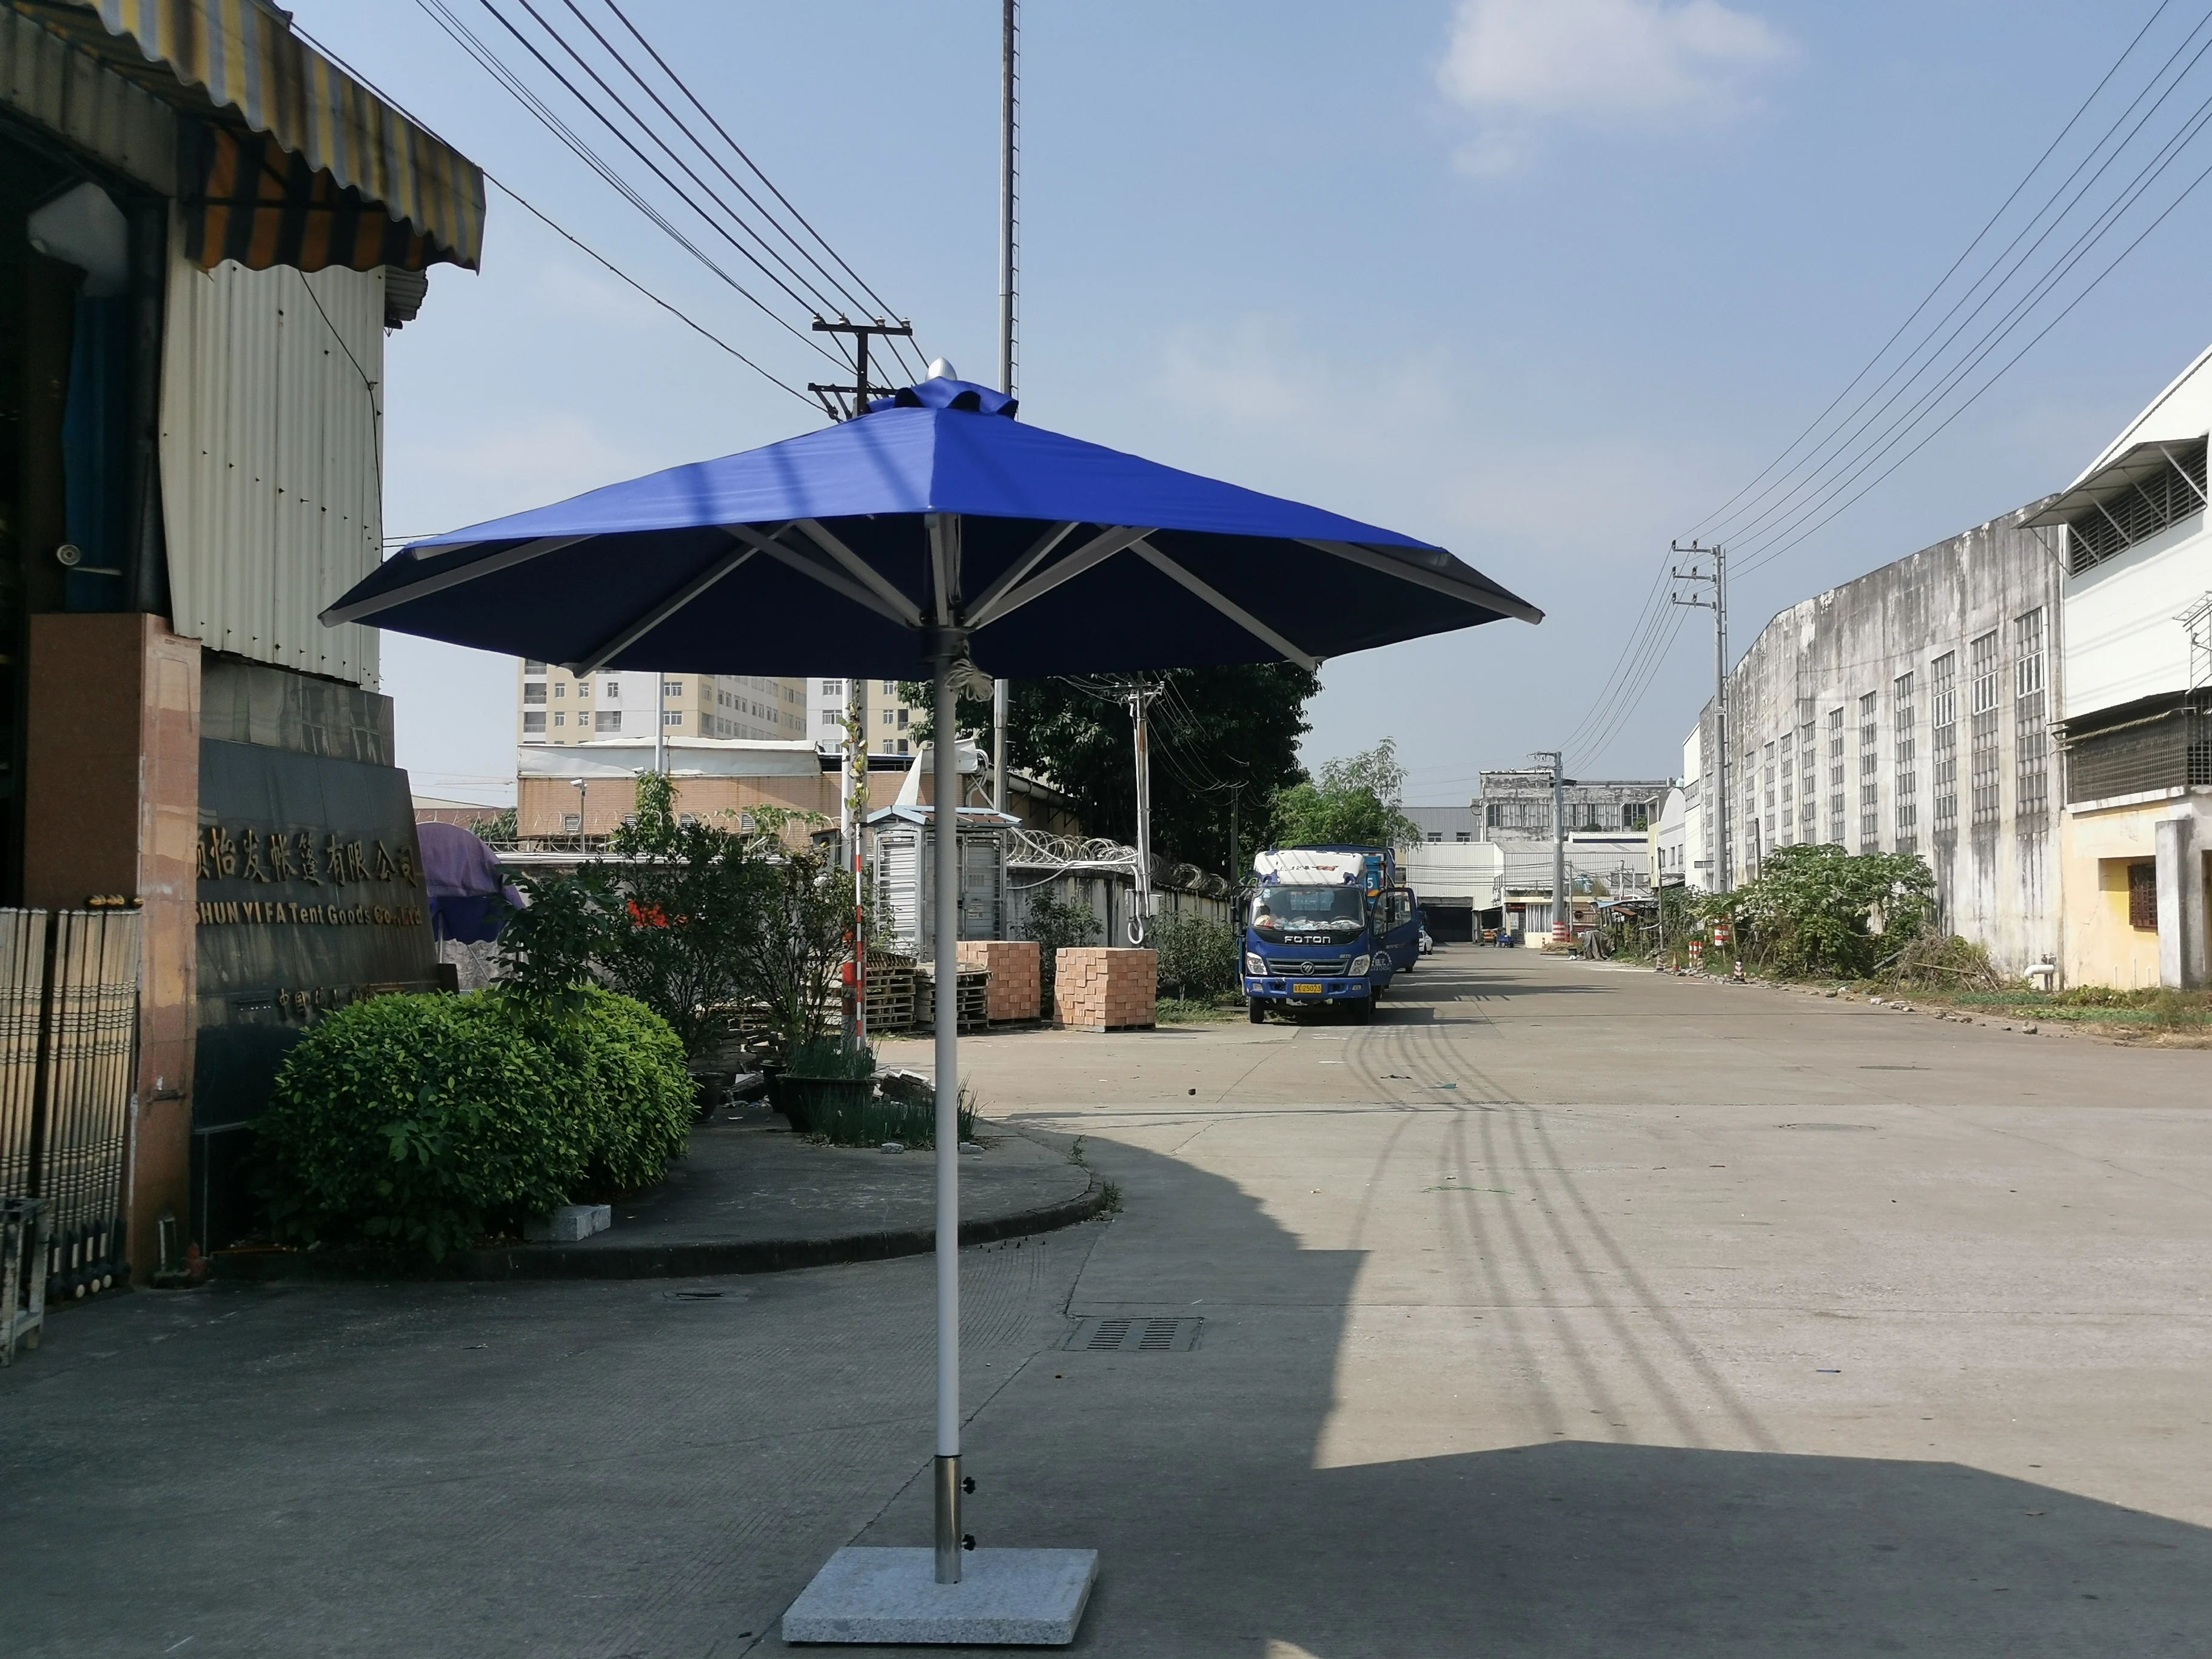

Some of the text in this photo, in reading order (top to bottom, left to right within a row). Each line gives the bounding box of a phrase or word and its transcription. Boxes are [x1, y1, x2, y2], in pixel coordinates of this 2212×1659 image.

[289, 902, 324, 925] Tent
[327, 904, 372, 925] Goods
[1284, 936, 1331, 944] FOTON
